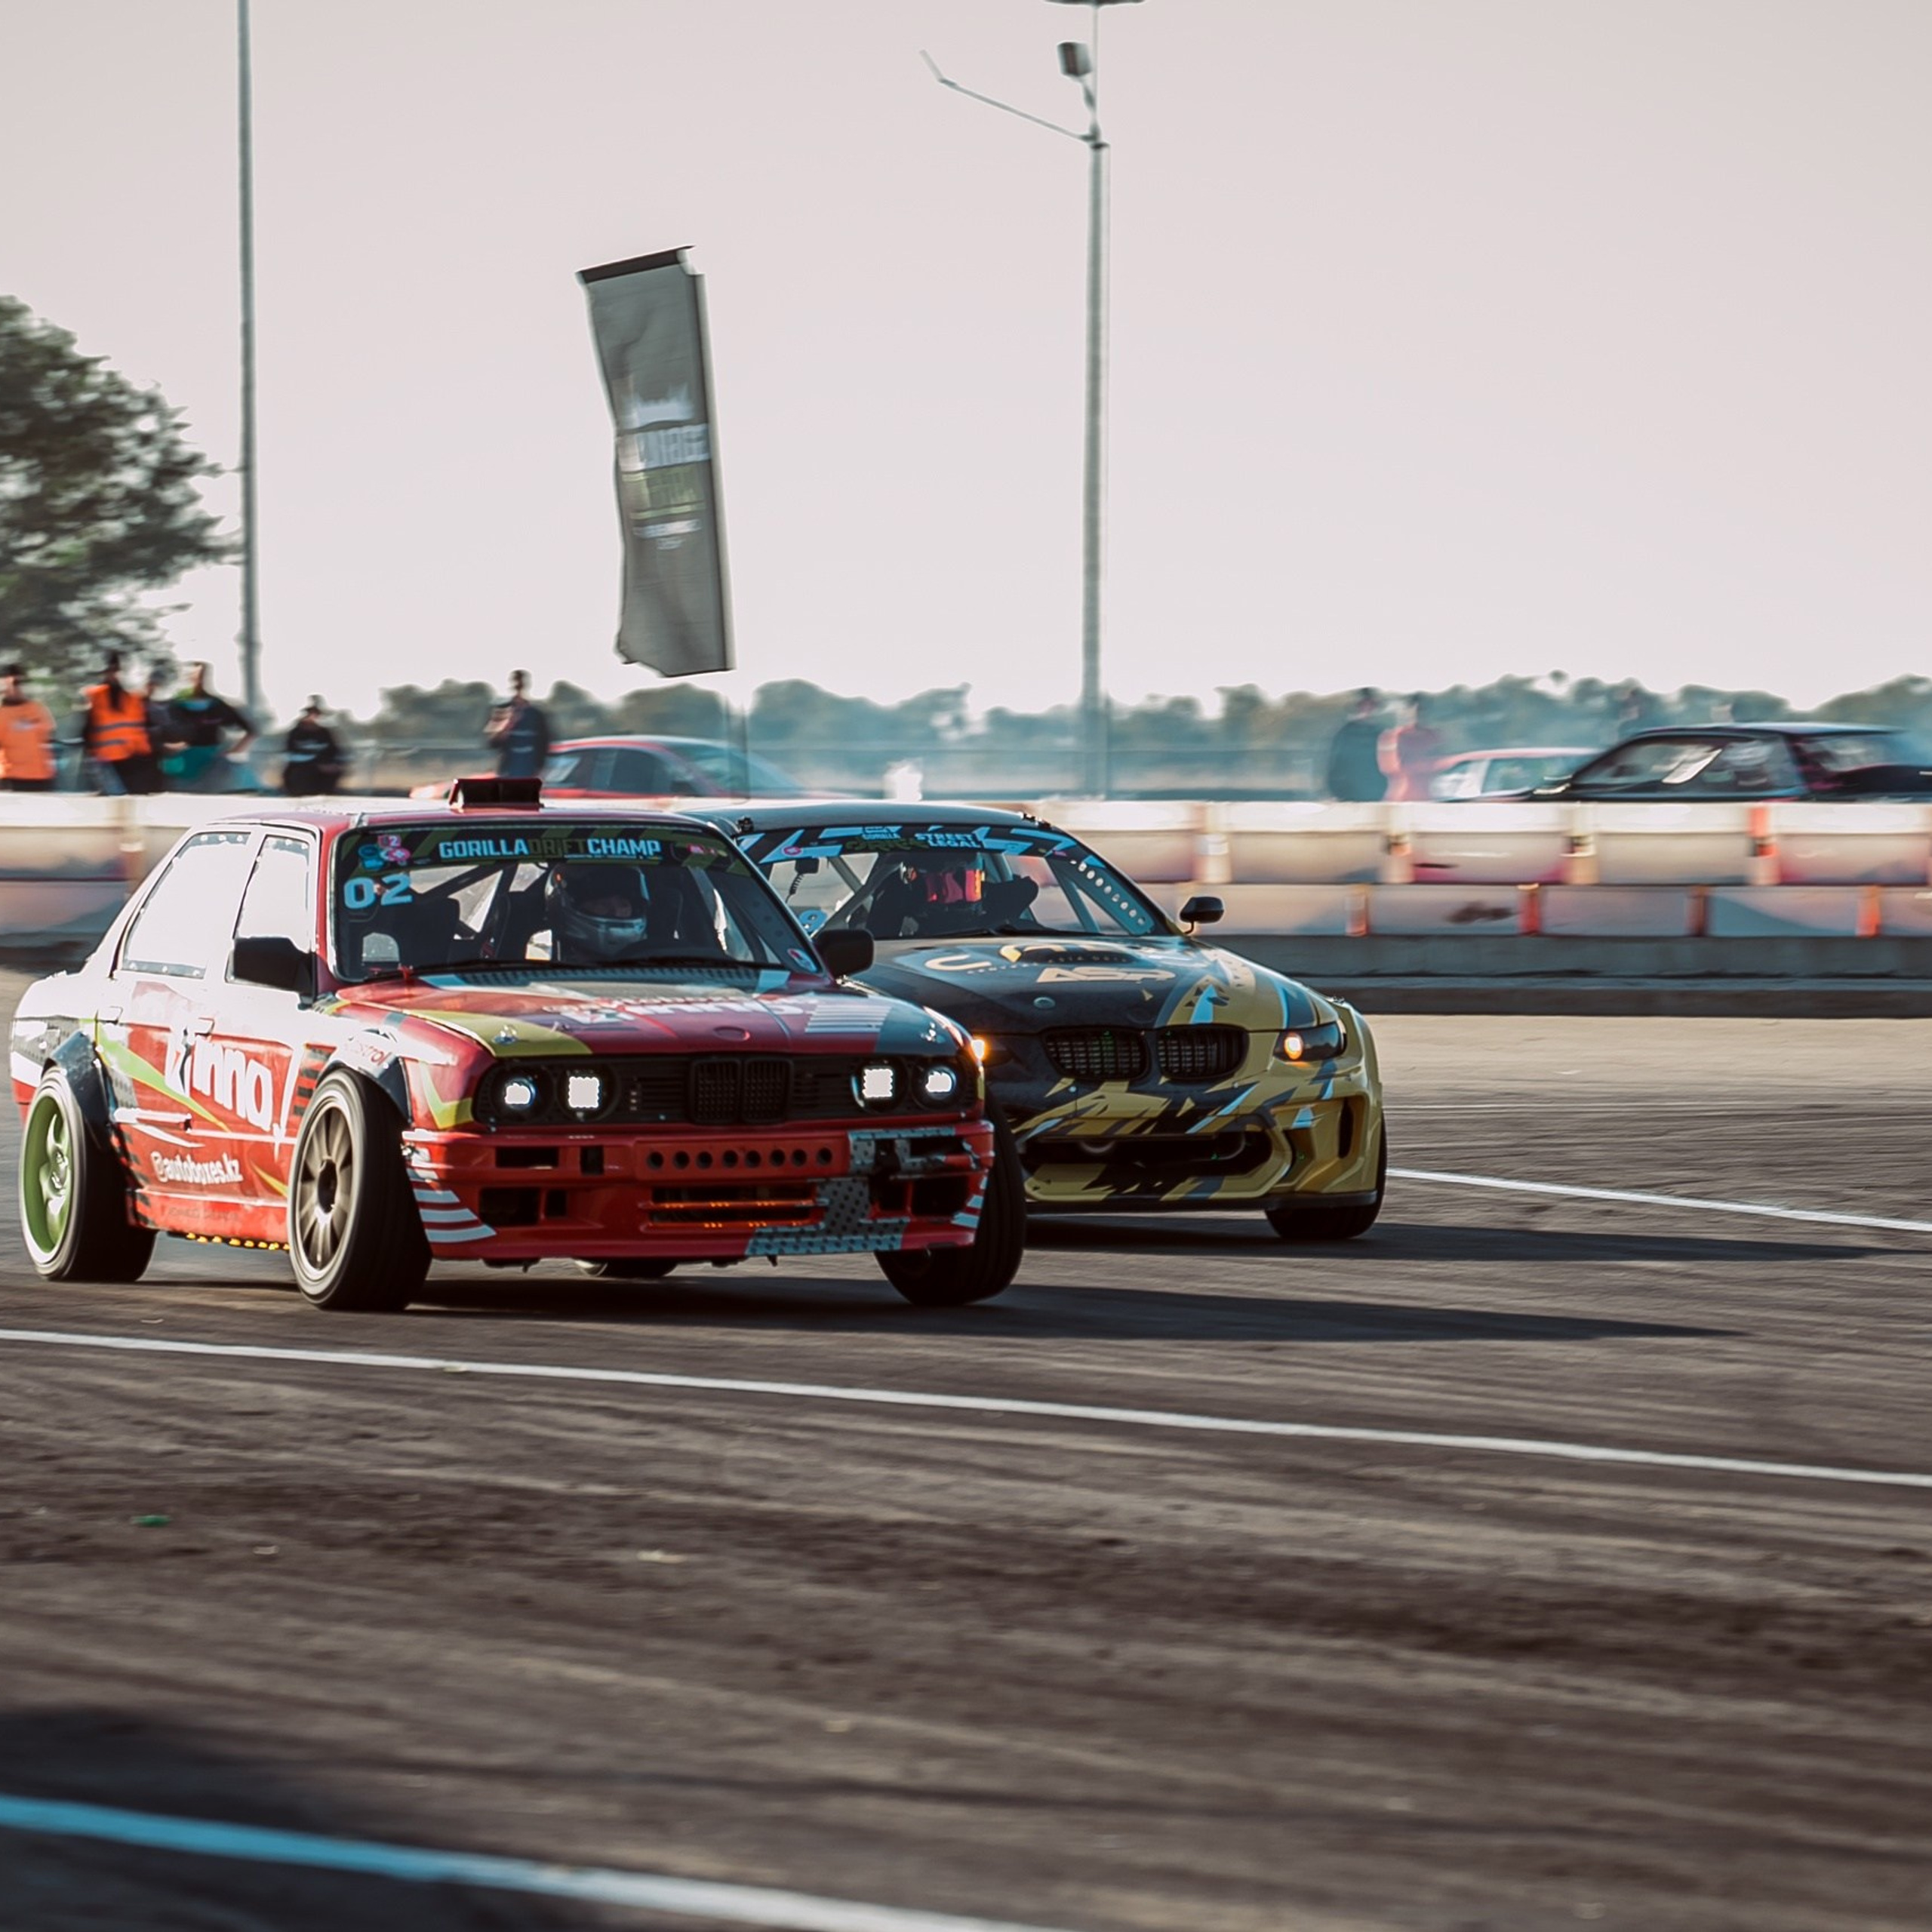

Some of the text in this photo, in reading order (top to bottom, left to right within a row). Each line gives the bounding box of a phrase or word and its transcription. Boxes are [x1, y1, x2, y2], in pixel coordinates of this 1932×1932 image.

[438, 839, 529, 858] GORILLA
[586, 838, 661, 856] CHAMP
[343, 872, 414, 909] 02
